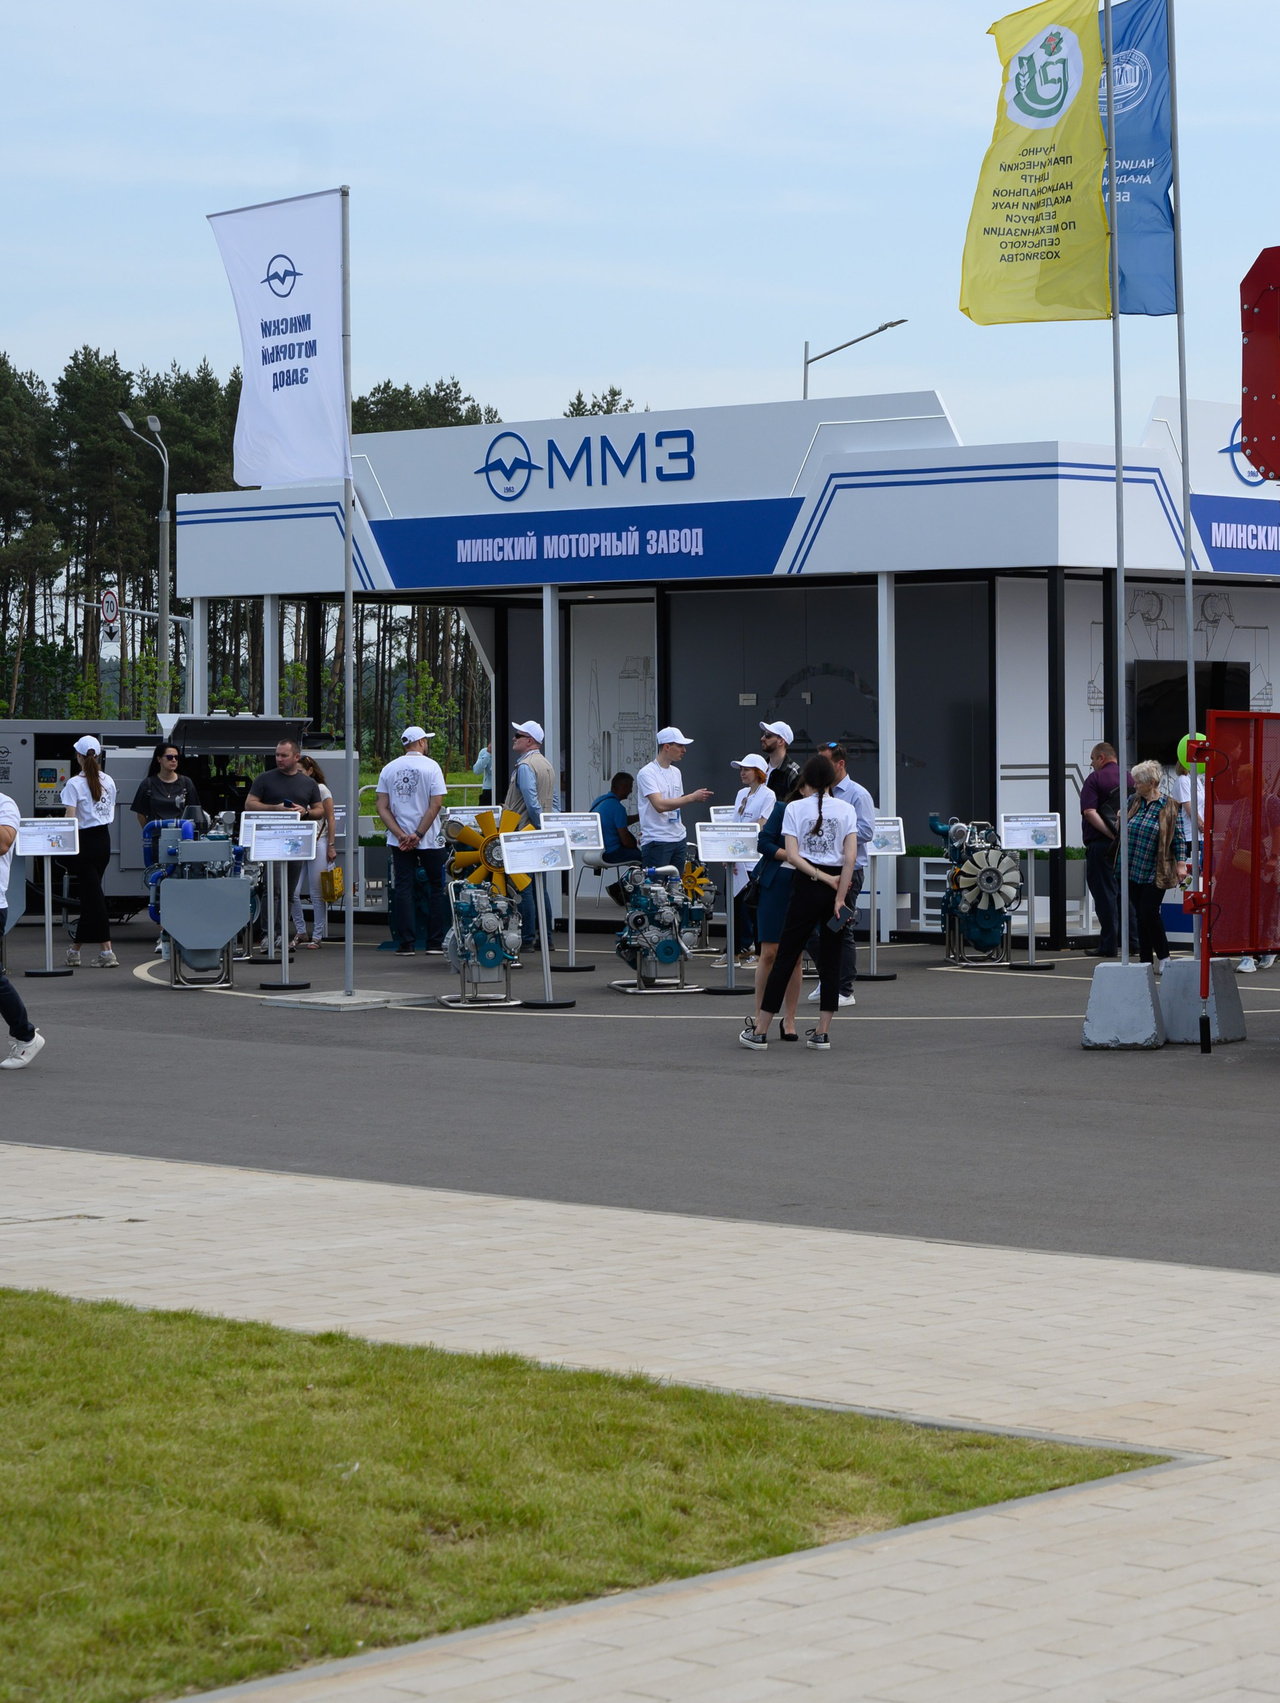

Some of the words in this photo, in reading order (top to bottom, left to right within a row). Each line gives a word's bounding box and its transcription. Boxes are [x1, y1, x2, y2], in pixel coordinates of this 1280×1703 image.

[548, 429, 696, 489] ММЗ
[456, 531, 537, 563] МИНСКИЙ
[544, 526, 640, 560] МОТОРНЫЙ
[646, 528, 704, 556] ЗАВОД
[106, 600, 114, 613] 70
